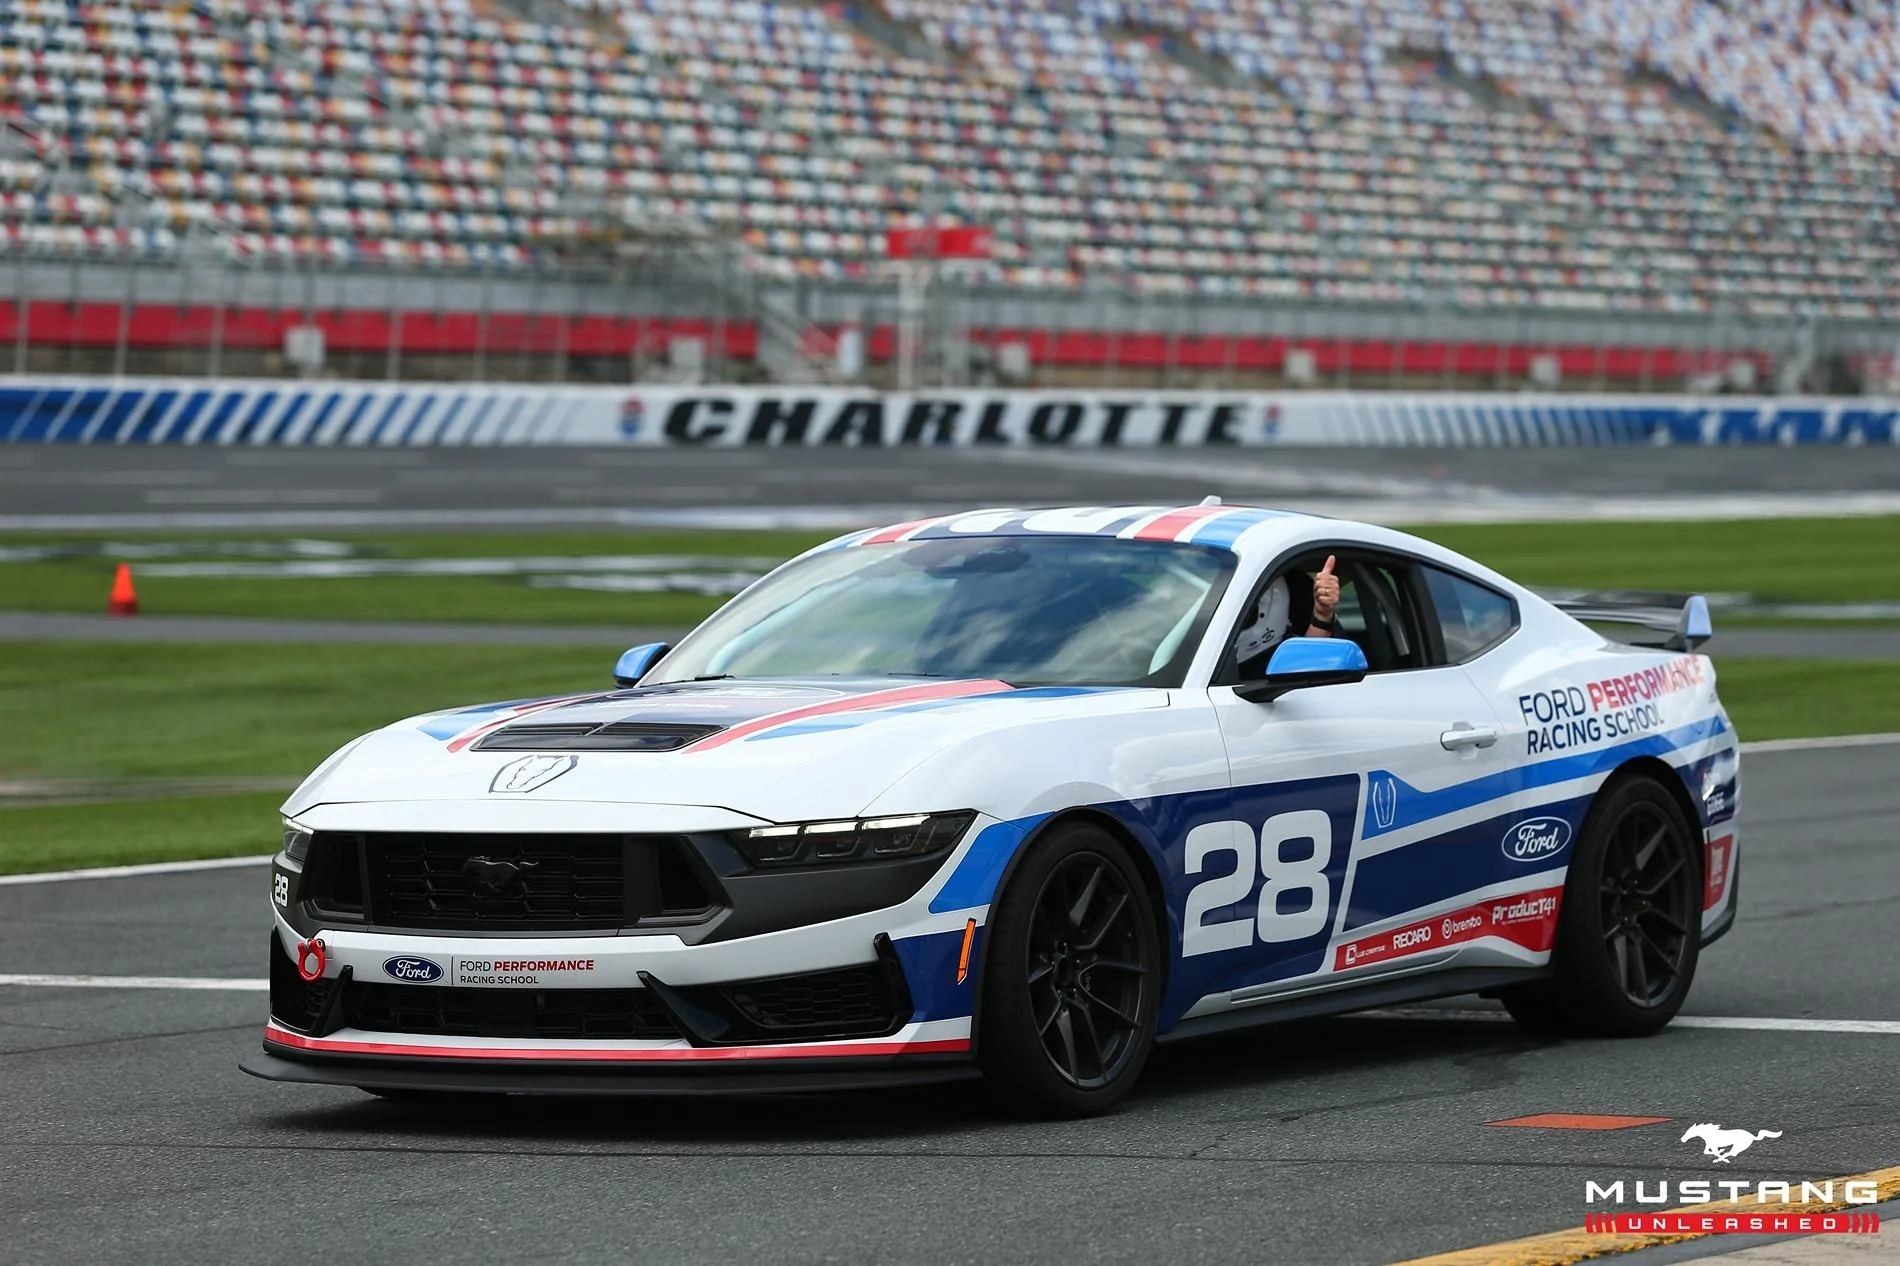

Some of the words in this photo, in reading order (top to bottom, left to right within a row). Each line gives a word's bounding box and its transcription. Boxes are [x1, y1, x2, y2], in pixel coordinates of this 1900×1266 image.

[662, 399, 1247, 446] CHARLOTTE
[1519, 686, 1586, 726] FORD
[1586, 655, 1703, 712] PERFORMANCE
[1527, 718, 1601, 755] RACING
[1603, 703, 1665, 738] SCHOOL
[1515, 823, 1559, 856] Ford
[274, 873, 289, 907] 28
[1182, 809, 1332, 958] 28
[1393, 926, 1432, 950] RECARO
[1453, 916, 1482, 933] brembo
[395, 960, 432, 979] Ford
[459, 960, 491, 972] FORD
[493, 960, 595, 972] PERFORMANCE
[459, 975, 496, 984] RACING
[498, 975, 539, 984] SCHOOL
